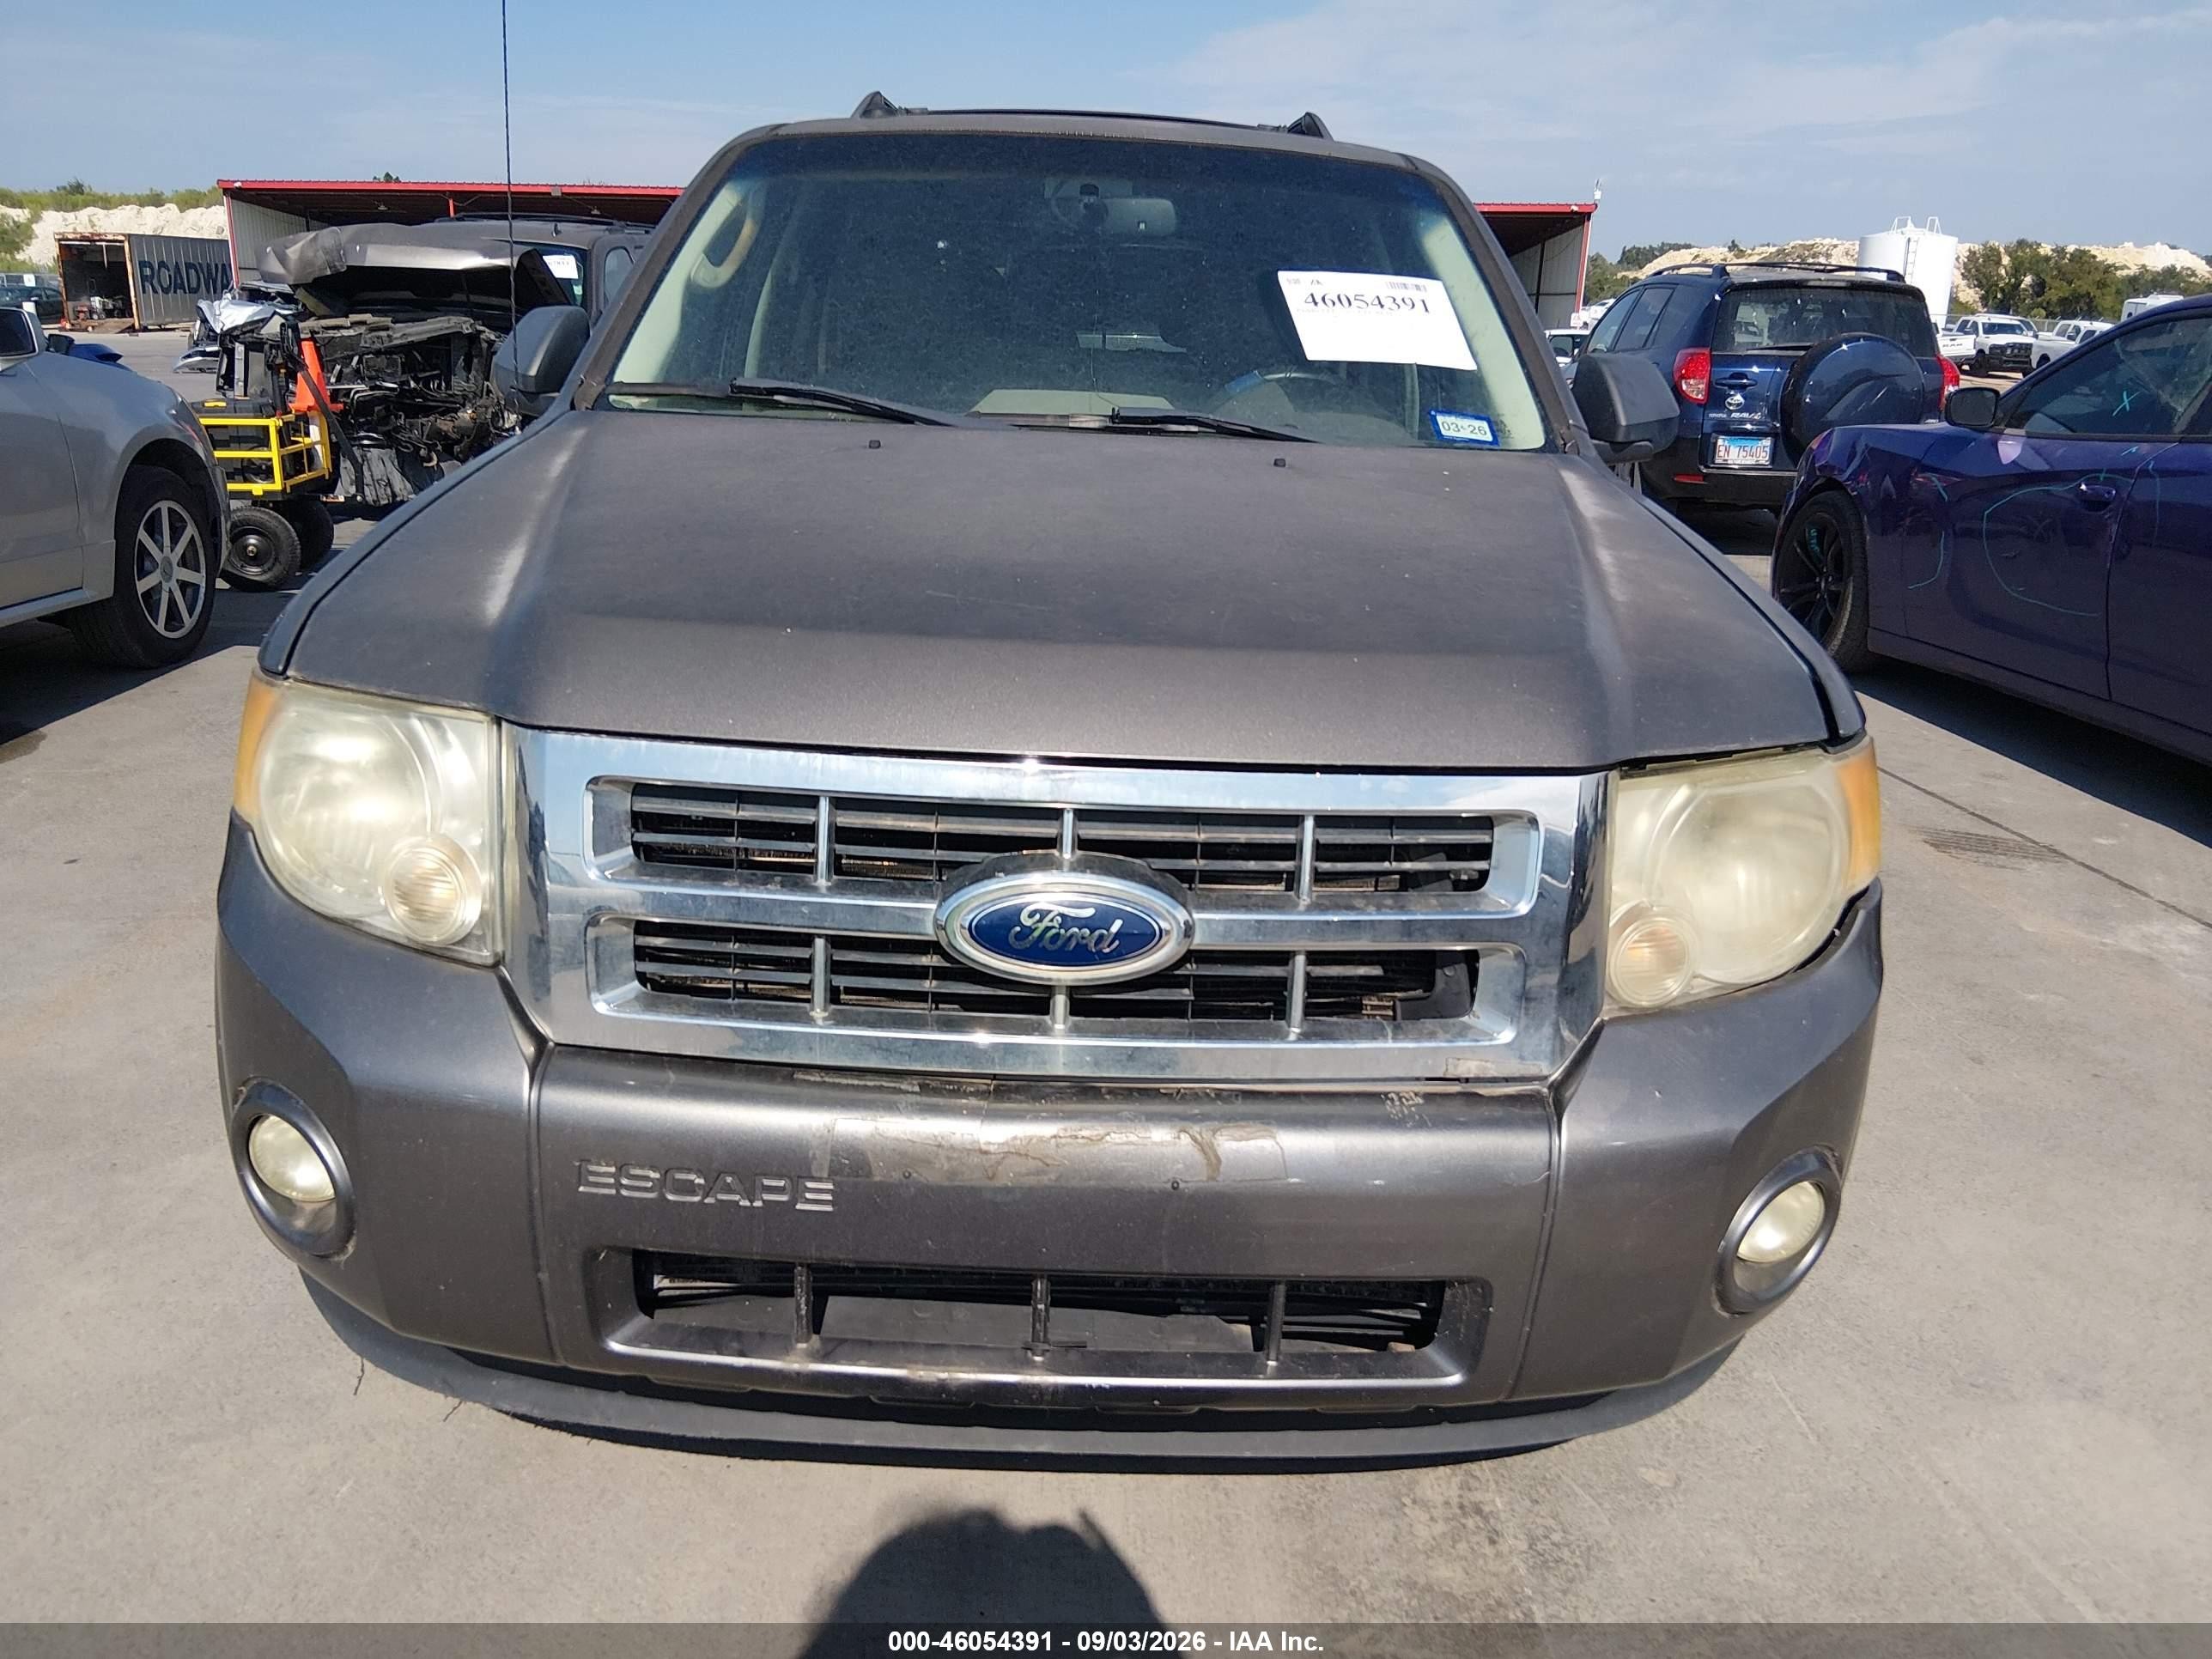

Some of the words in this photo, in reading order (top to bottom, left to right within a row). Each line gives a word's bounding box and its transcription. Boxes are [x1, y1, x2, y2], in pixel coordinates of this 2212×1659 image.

[138, 260, 234, 294] ROADWA
[1304, 292, 1431, 313] 46054391
[1717, 445, 1730, 459] EN
[1737, 446, 1768, 459] 75405
[1009, 902, 1124, 954] Ford
[578, 1161, 836, 1212] ESCAPE
